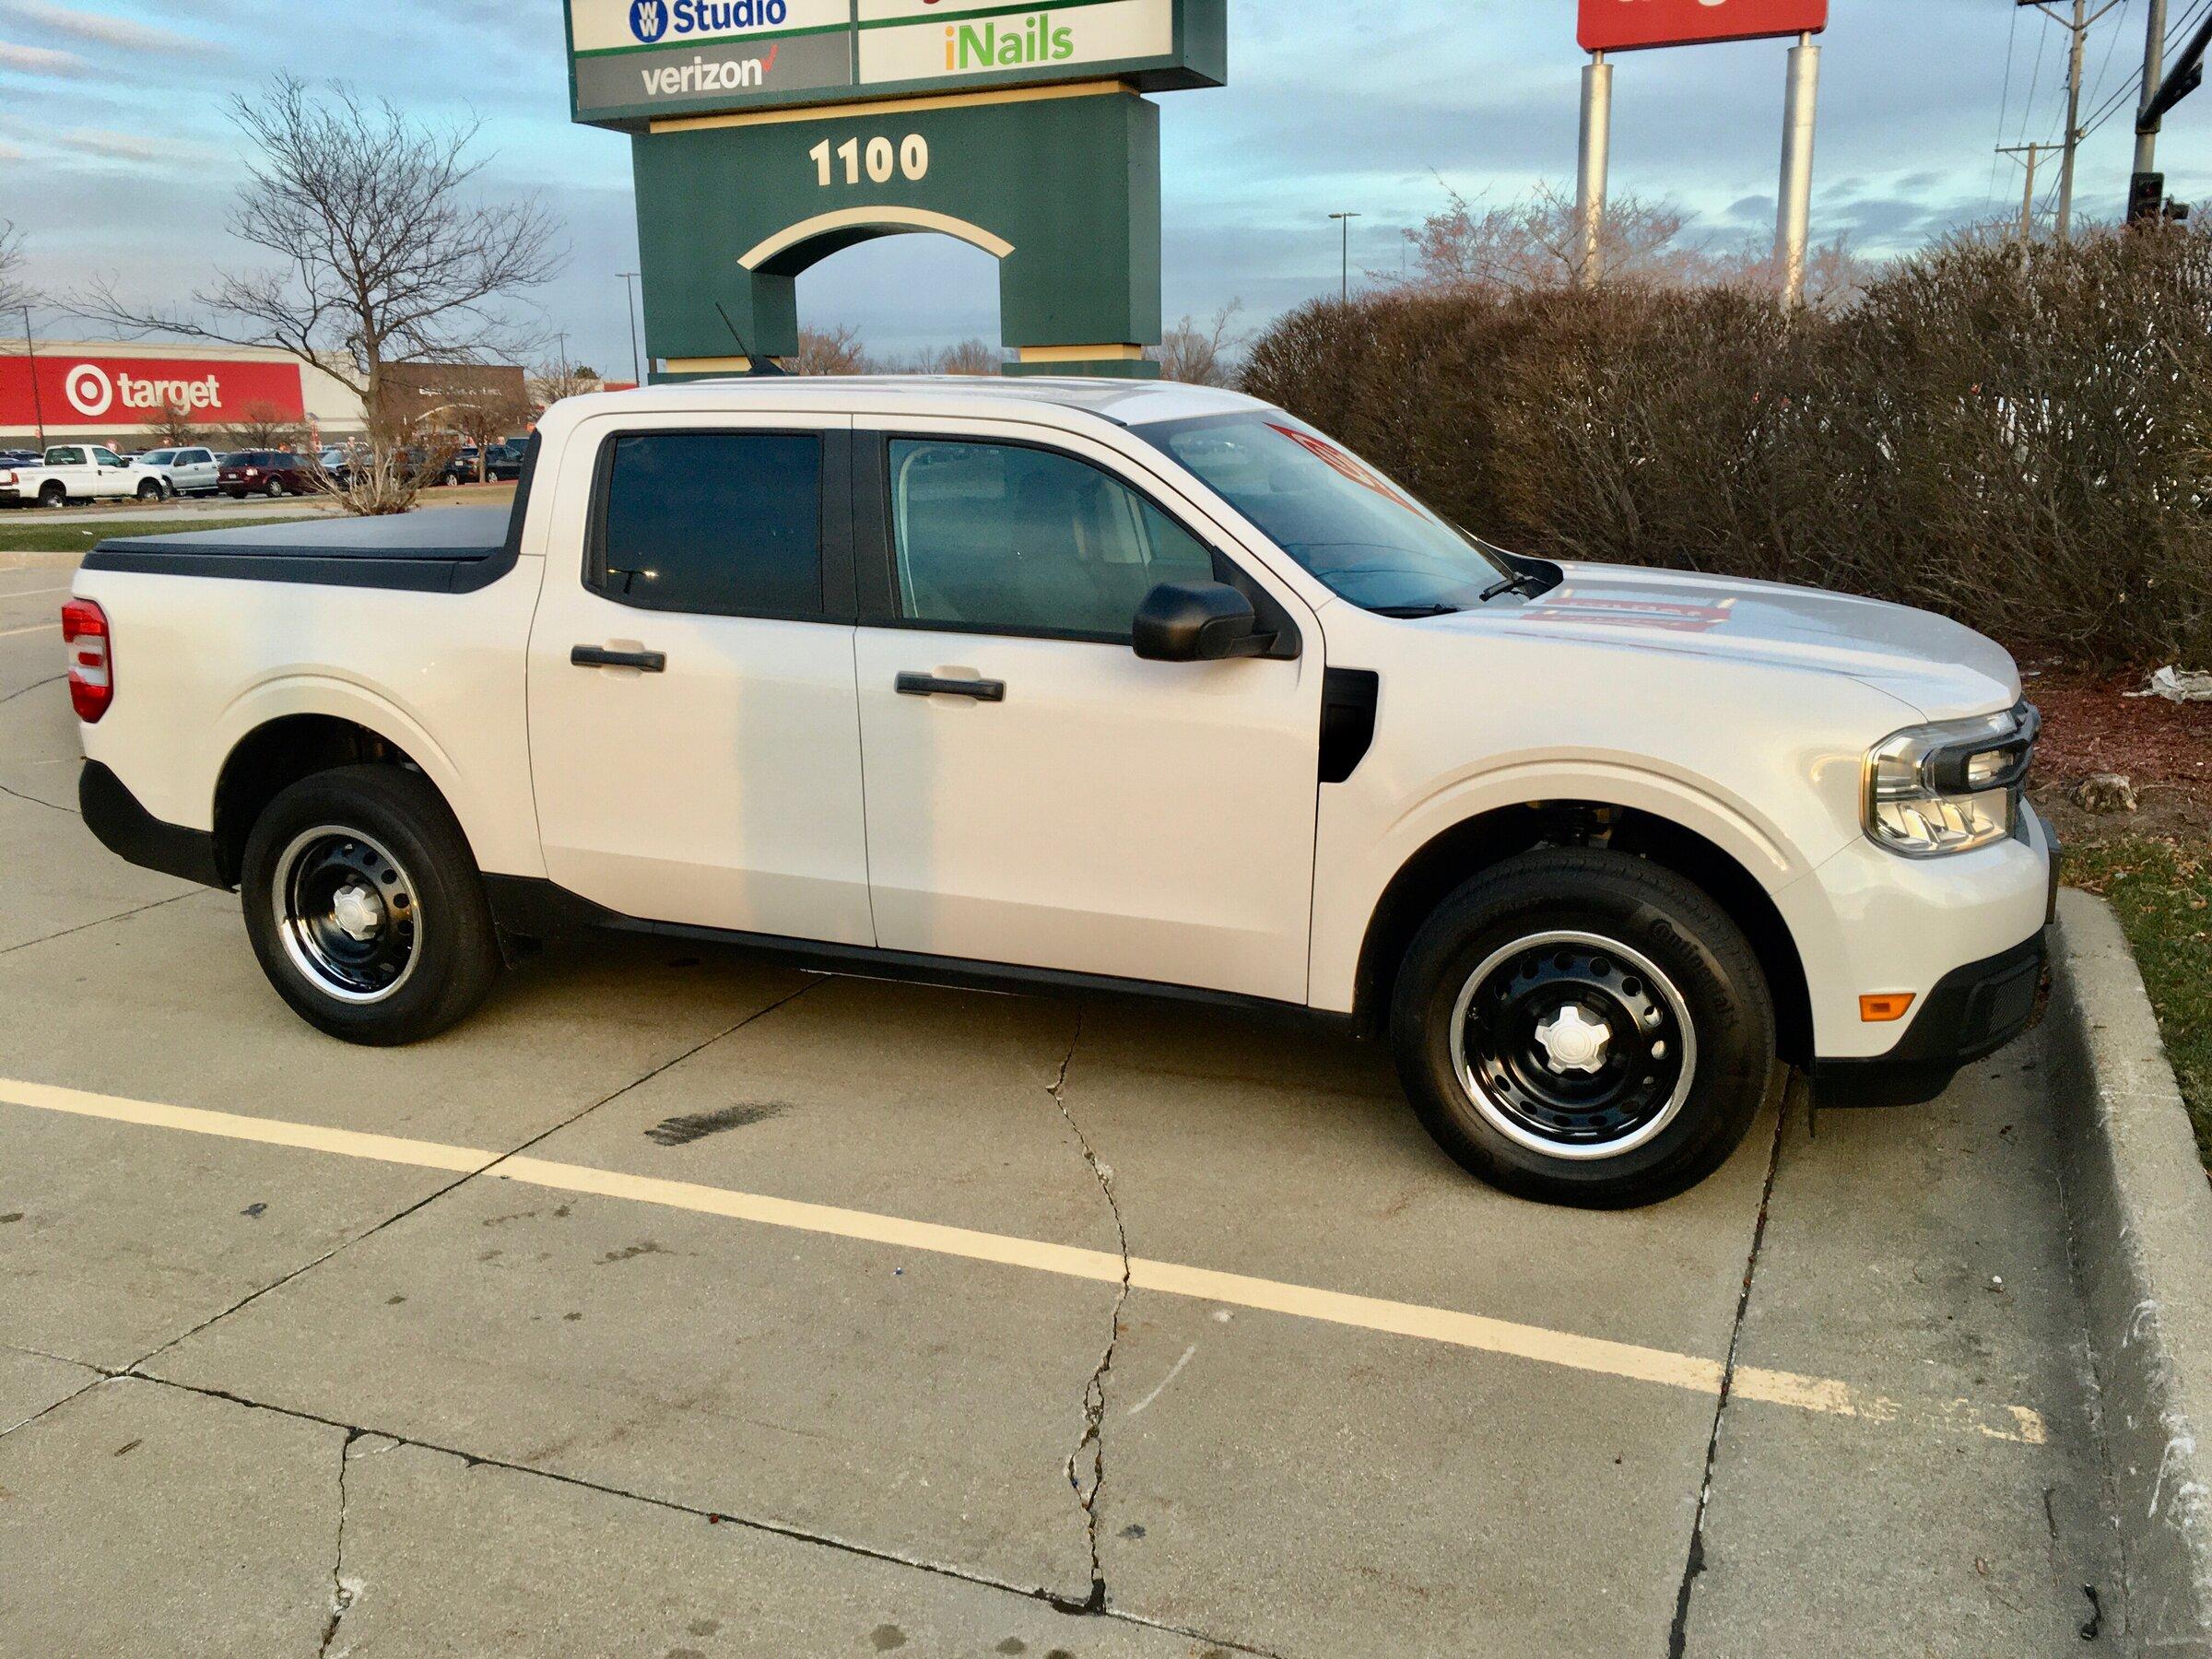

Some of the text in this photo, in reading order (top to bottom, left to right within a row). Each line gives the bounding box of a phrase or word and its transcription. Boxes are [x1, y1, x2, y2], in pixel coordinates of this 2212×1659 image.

[674, 0, 786, 33] Studio
[945, 13, 1075, 70] iNails
[641, 55, 763, 96] verizon
[808, 134, 928, 186] 1100
[117, 372, 222, 416] target
